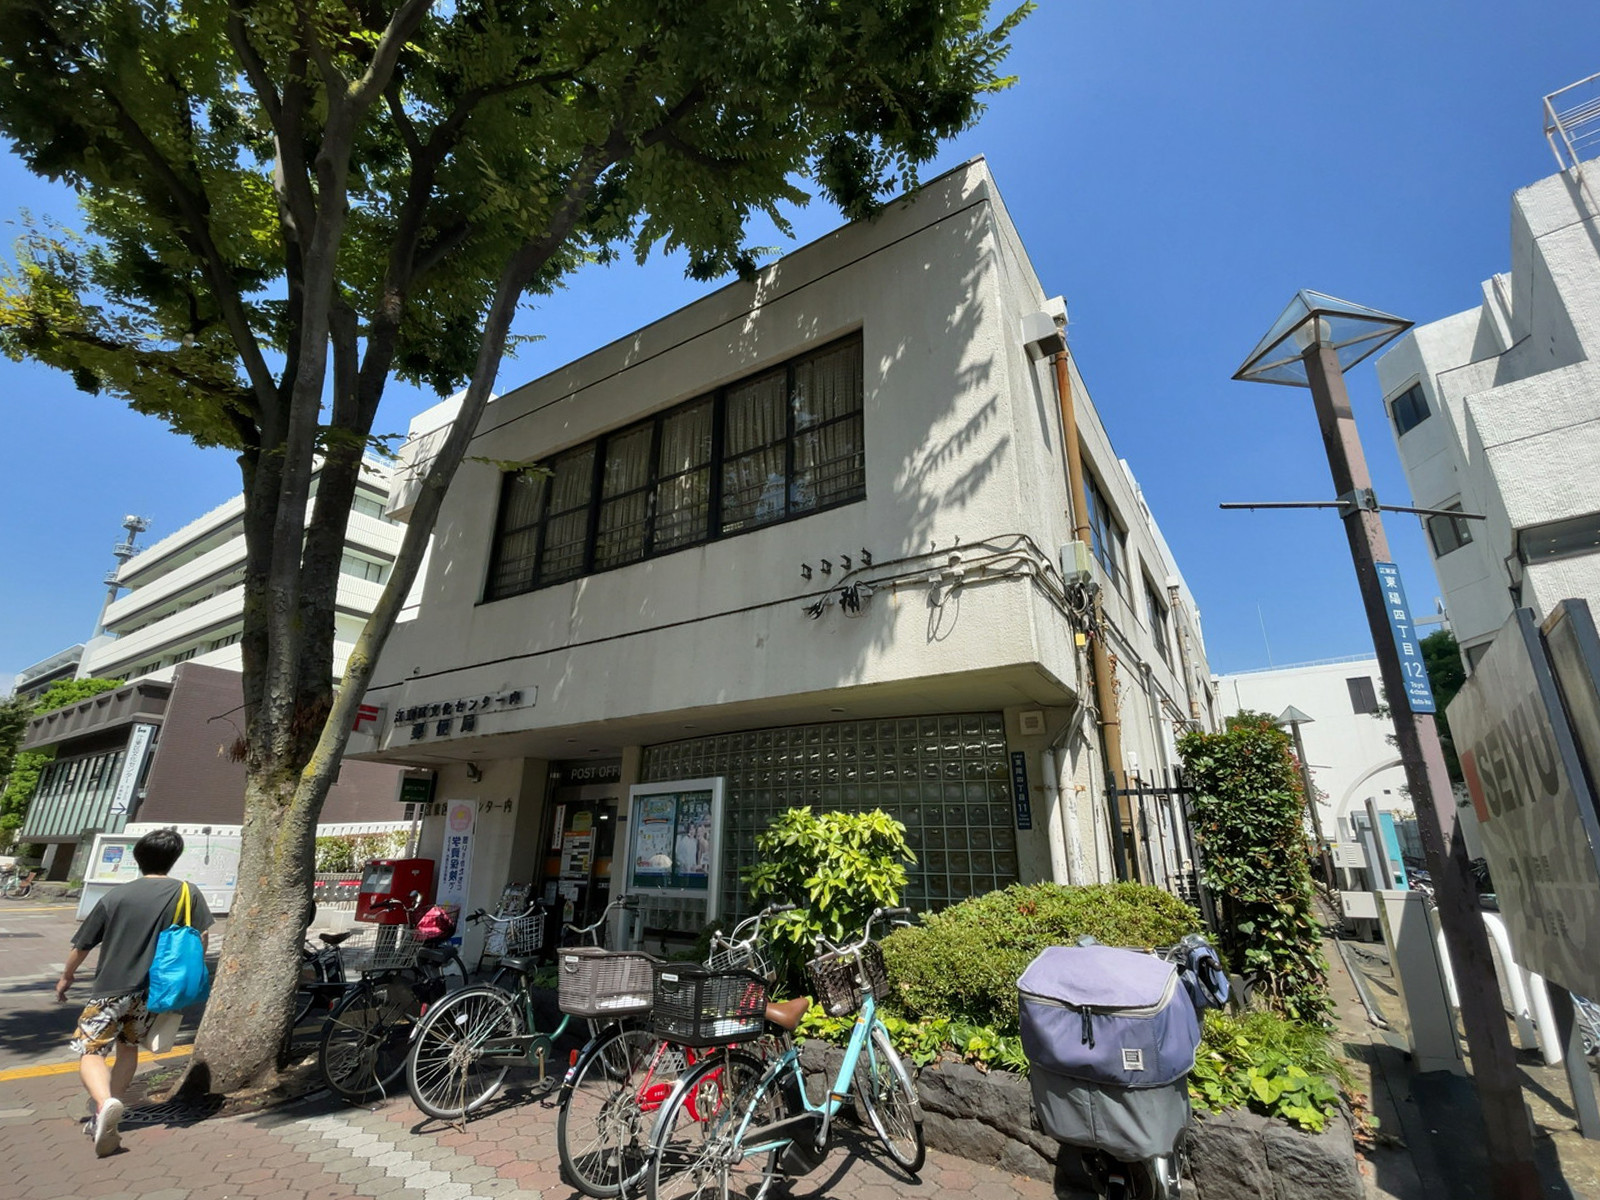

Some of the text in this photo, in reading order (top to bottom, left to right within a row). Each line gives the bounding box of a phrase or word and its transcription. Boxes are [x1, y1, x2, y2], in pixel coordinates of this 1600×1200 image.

[1384, 576, 1424, 678] 東陽四丁目 12
[570, 767, 596, 781] POST
[1474, 690, 1560, 818] SEIYU
